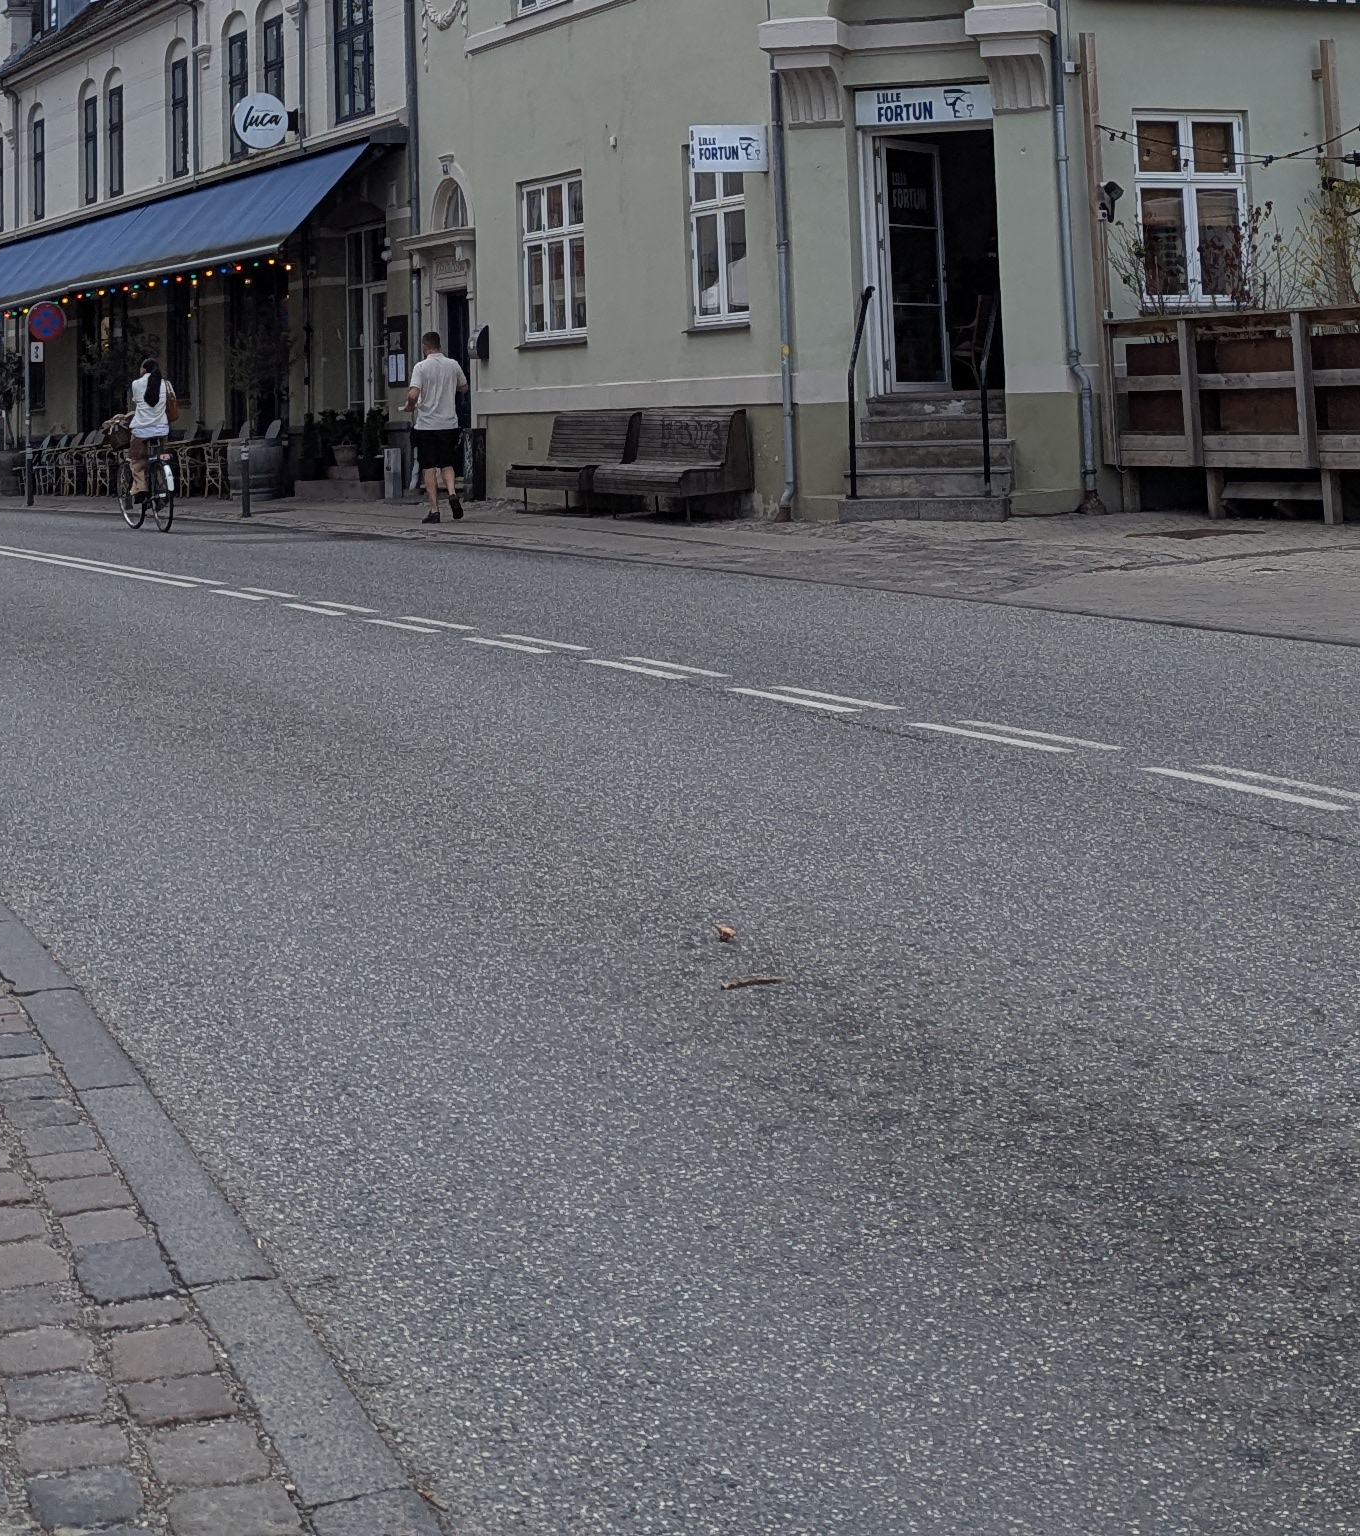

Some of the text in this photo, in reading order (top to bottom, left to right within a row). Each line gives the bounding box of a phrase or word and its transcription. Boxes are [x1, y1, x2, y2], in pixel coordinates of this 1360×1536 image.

[876, 92, 901, 104] LILLE
[877, 101, 933, 122] FORTUN
[698, 137, 716, 146] LILLE
[699, 146, 739, 160] FORTUN
